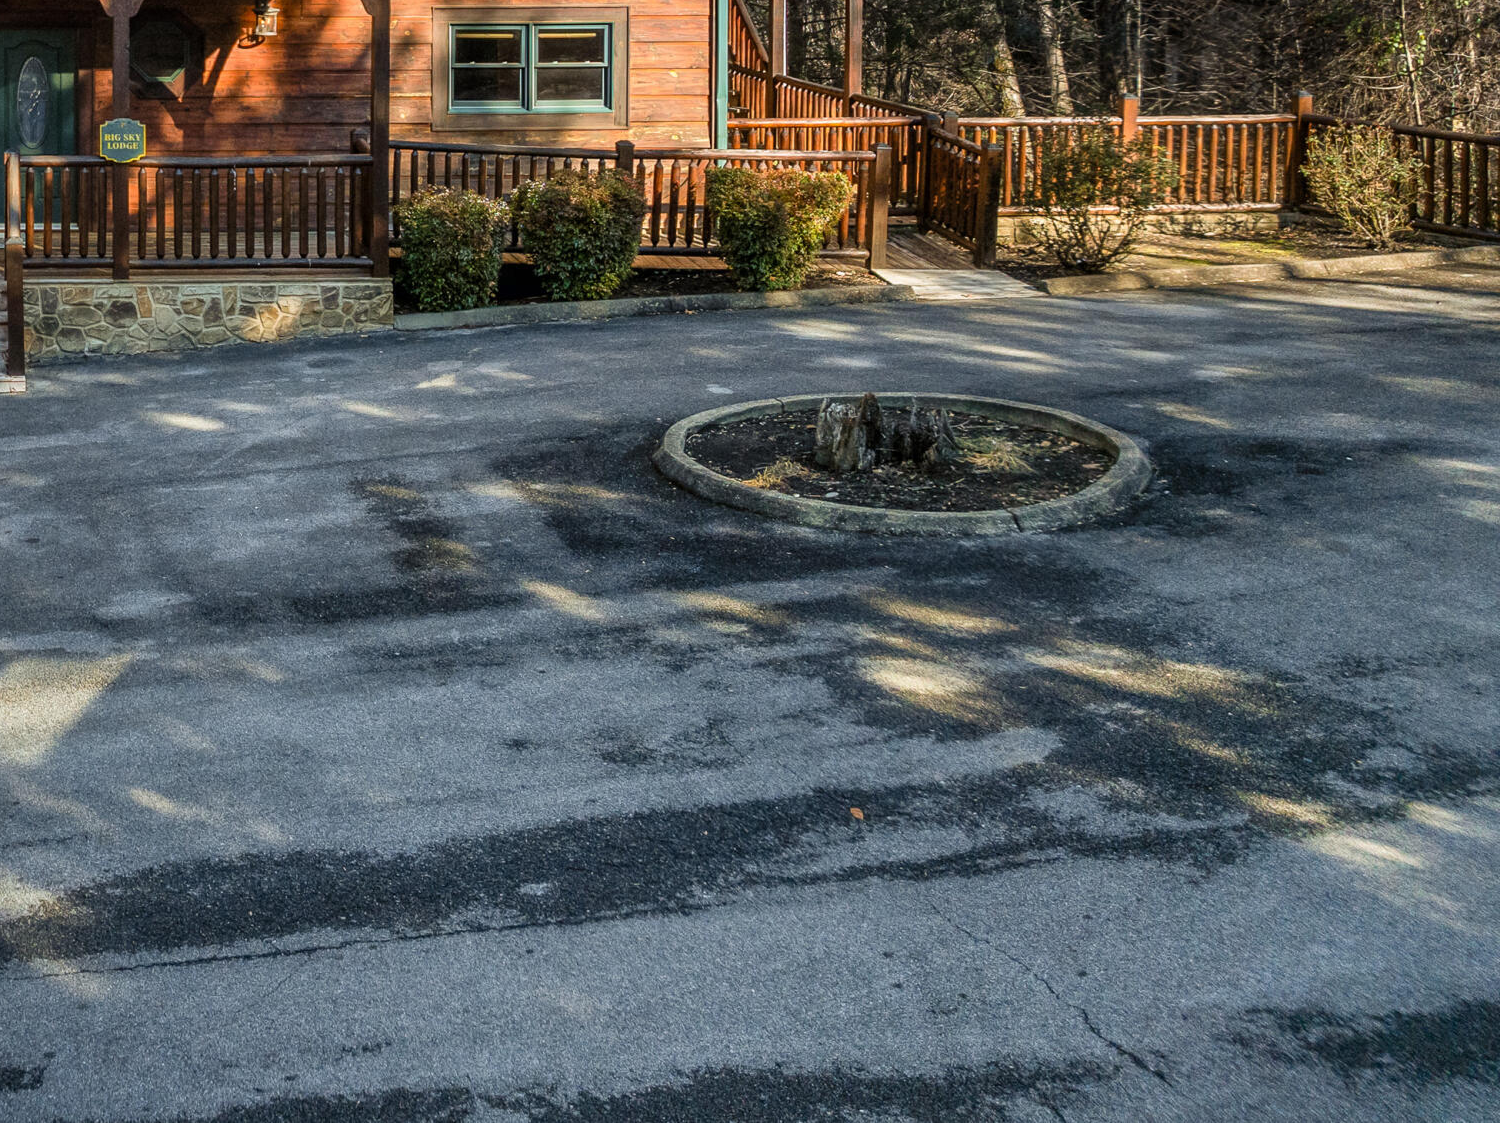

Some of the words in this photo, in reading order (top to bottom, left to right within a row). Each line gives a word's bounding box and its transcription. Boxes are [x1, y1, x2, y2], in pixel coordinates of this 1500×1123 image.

[104, 133, 121, 142] BIG
[123, 133, 141, 142] SKY
[107, 141, 139, 150] LODGE
